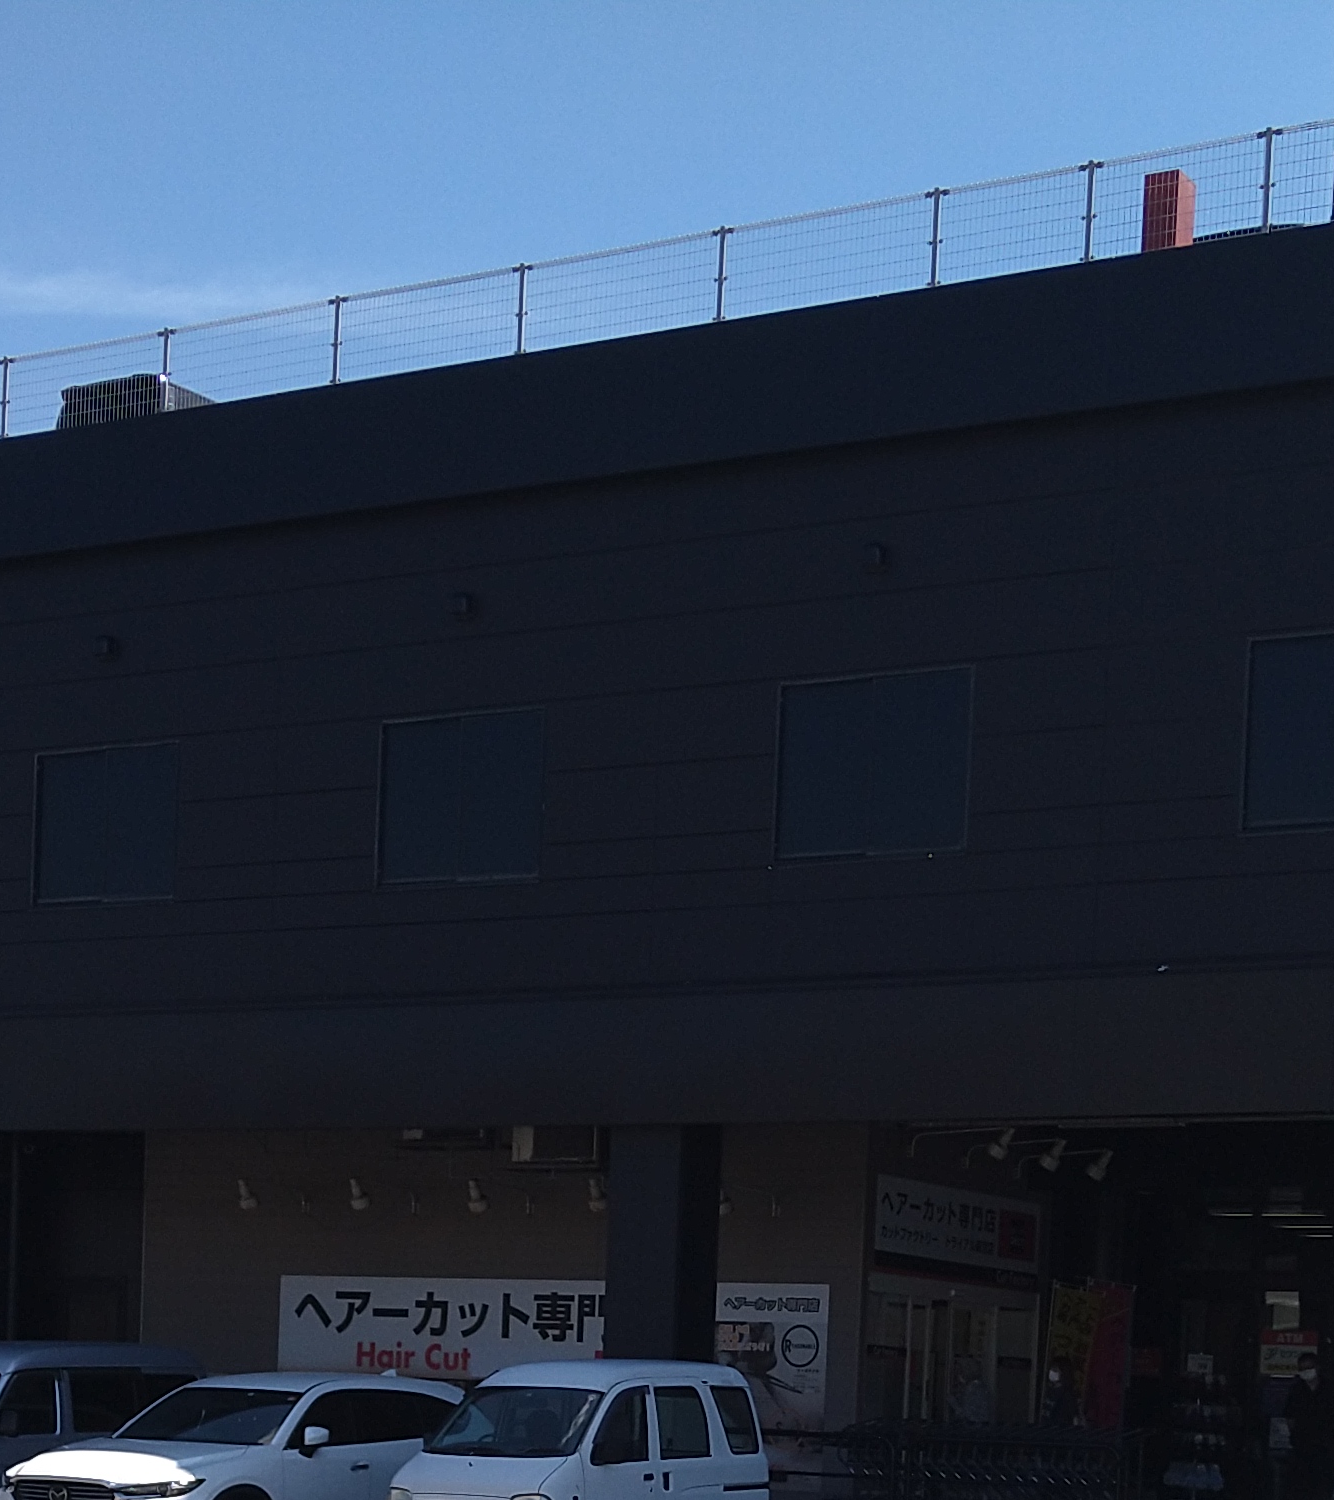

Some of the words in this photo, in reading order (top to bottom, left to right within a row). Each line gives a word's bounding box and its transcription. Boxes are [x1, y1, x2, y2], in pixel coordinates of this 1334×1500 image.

[1276, 1333, 1303, 1343] ATM
[356, 1341, 415, 1369] Hair
[424, 1343, 471, 1371] Cut
